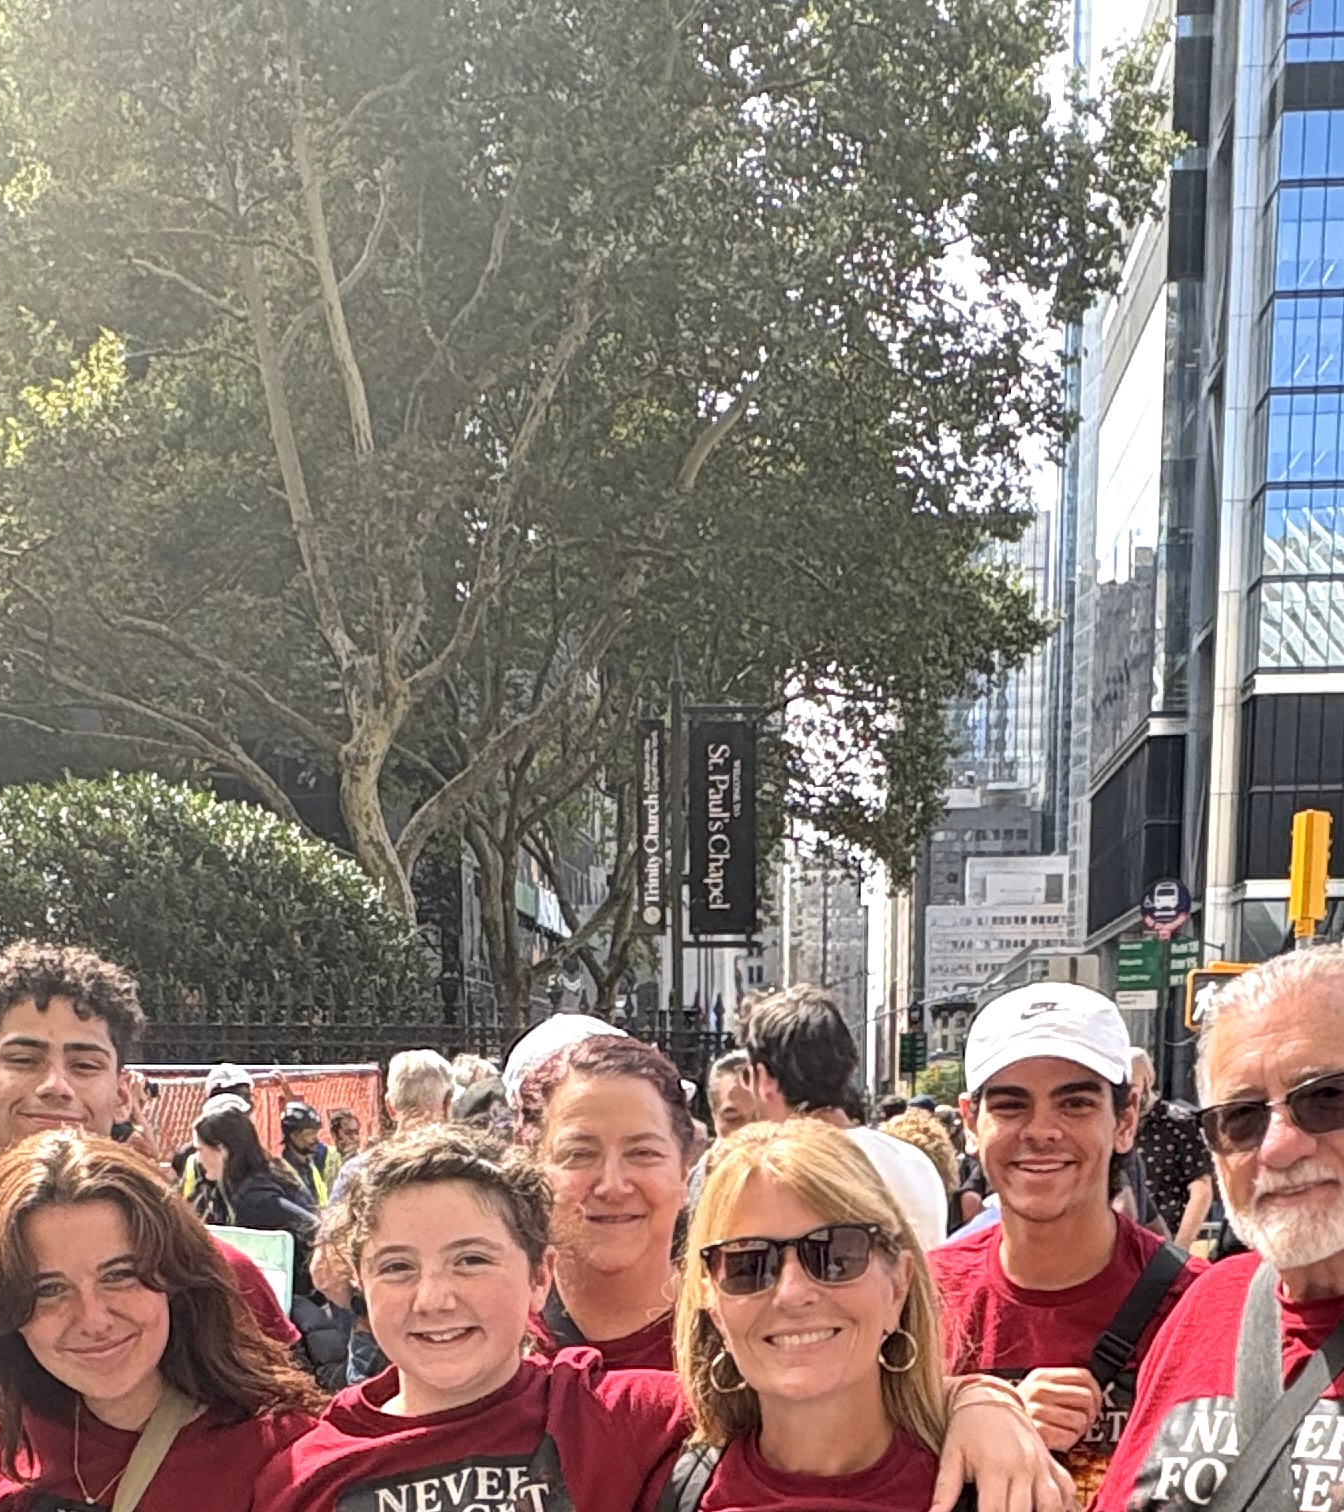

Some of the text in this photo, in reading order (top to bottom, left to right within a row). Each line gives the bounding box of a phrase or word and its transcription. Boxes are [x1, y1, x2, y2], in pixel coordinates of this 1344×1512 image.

[643, 793, 660, 854] Church
[703, 744, 732, 911] St. Paul's Chapel
[644, 855, 663, 905] Trinity
